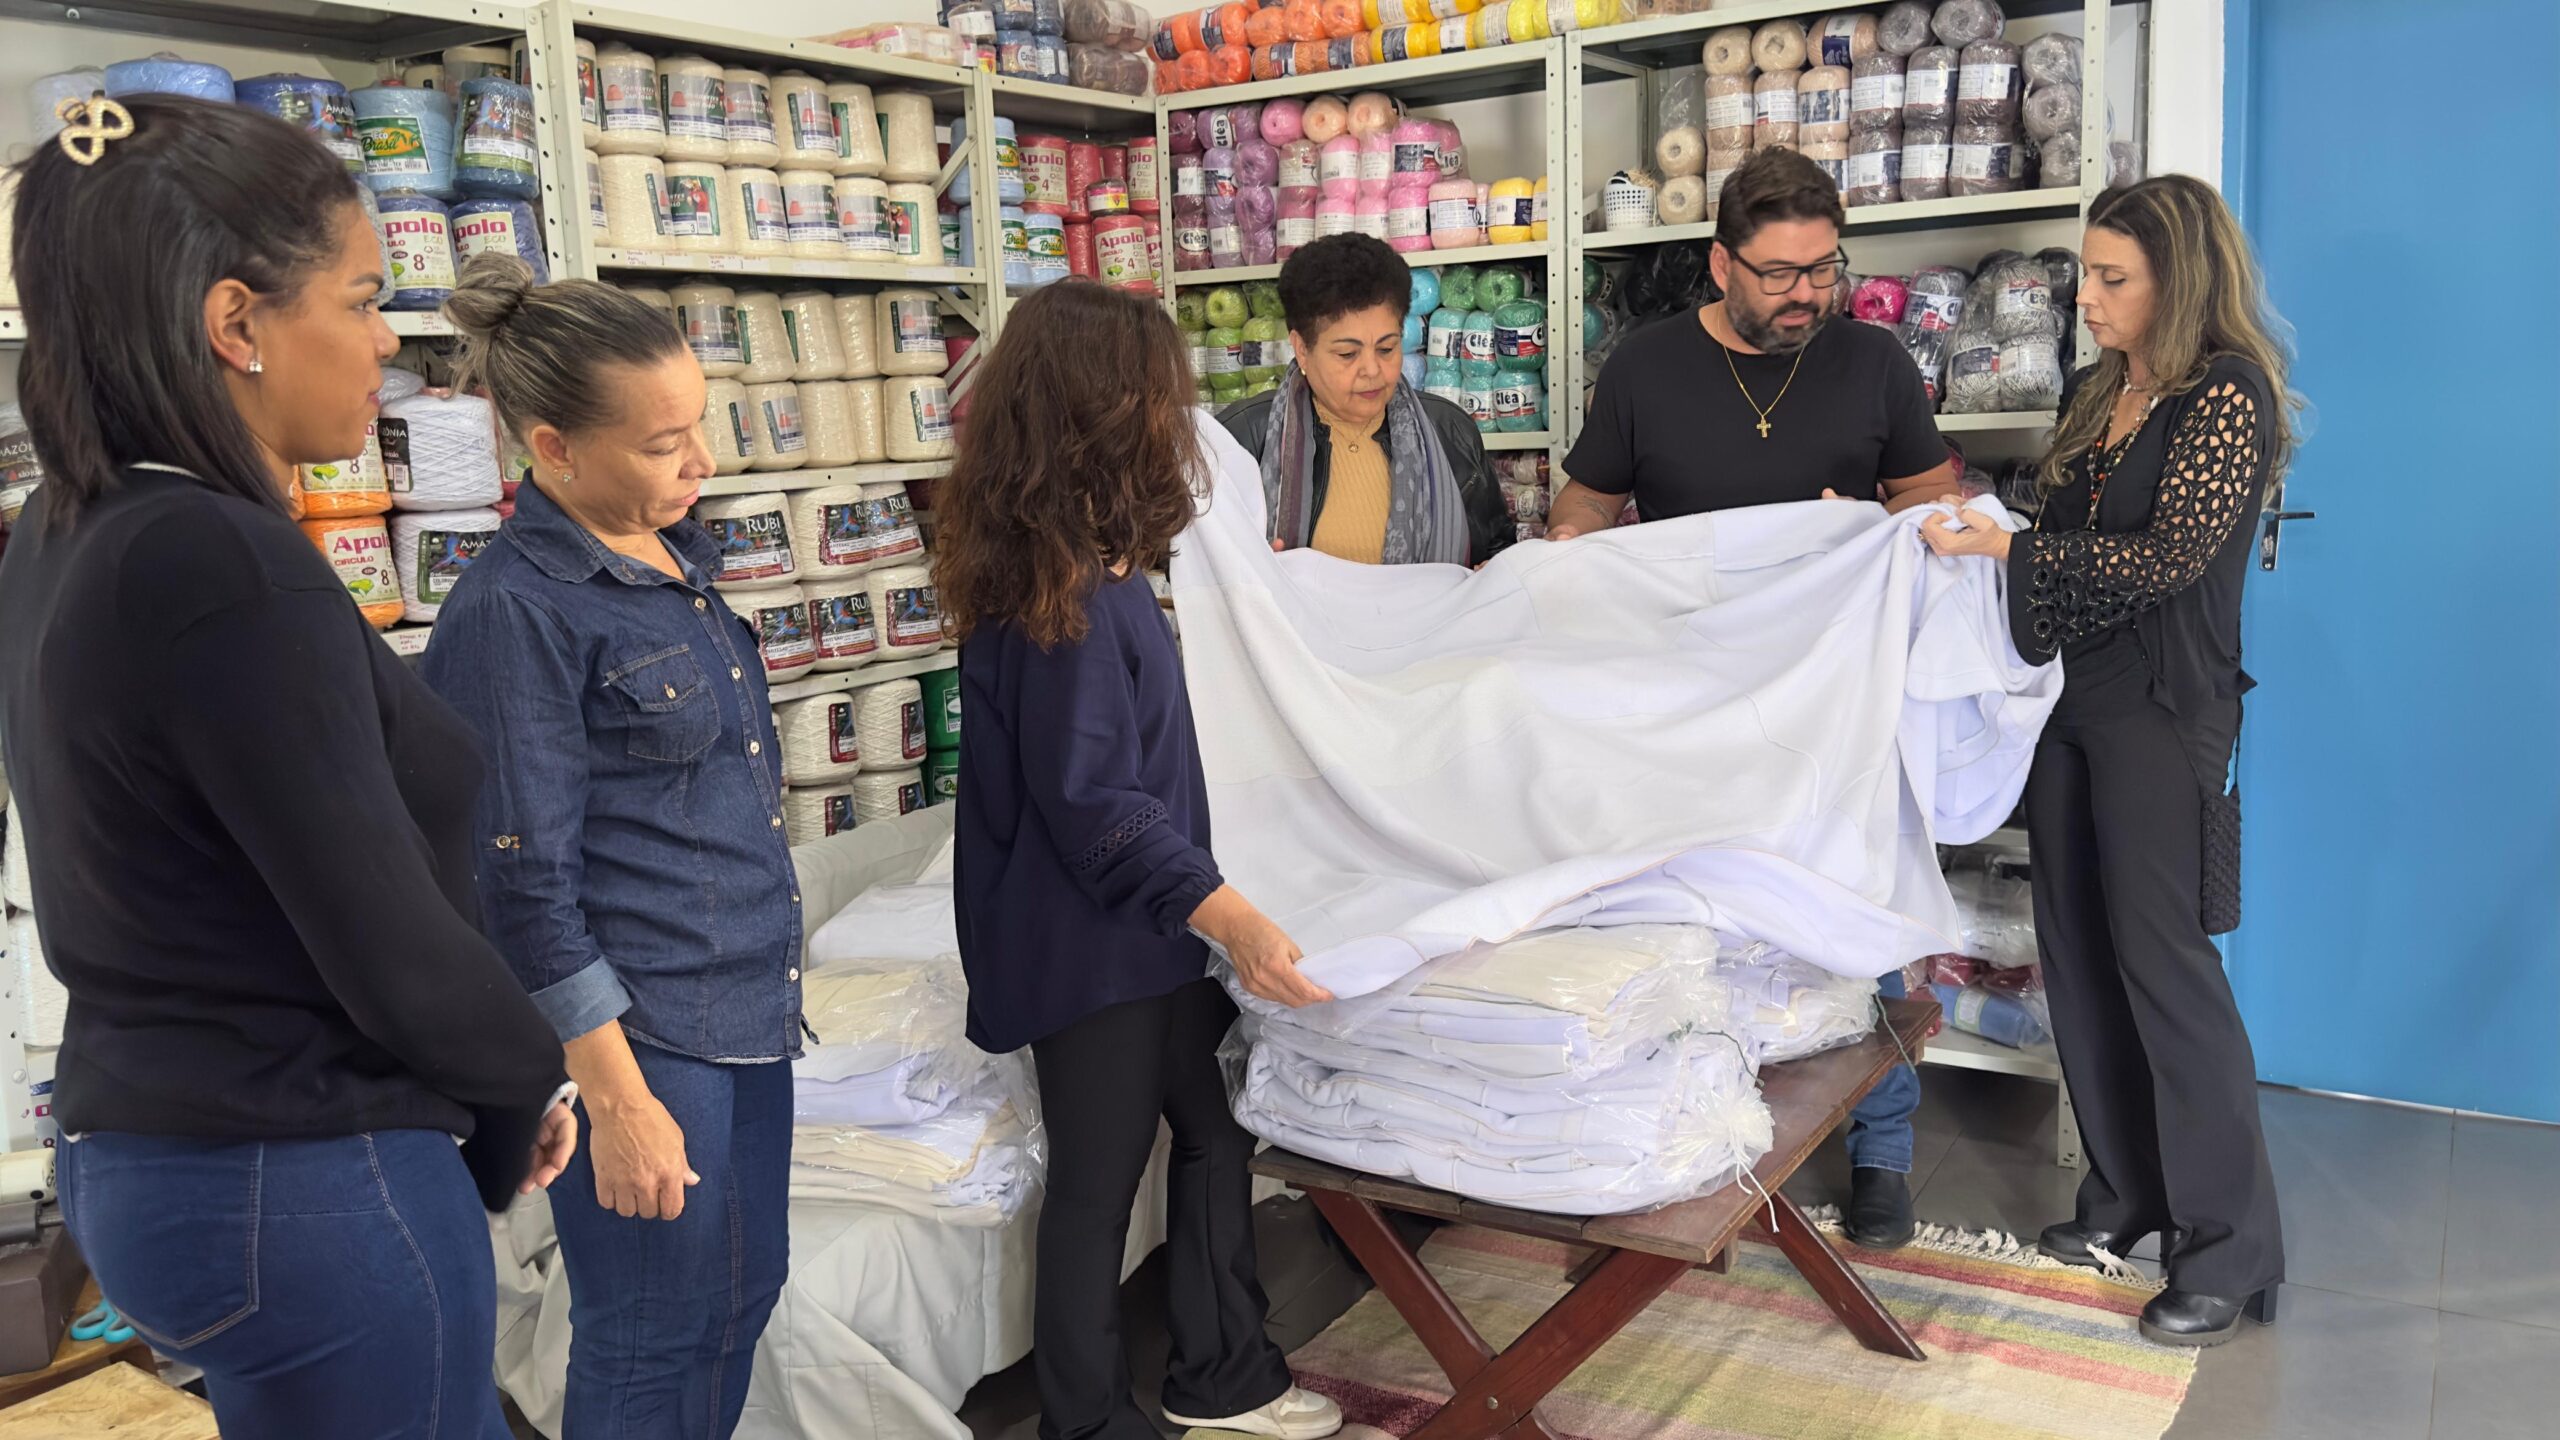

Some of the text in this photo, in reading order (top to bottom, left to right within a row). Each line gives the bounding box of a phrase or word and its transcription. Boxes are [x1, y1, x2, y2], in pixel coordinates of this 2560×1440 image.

[1042, 179, 1049, 191] 4
[1100, 232, 1143, 249] Apolo
[413, 254, 425, 271] 8
[1128, 258, 1135, 269] 4
[1495, 391, 1519, 405] Cléa
[746, 517, 780, 533] RUBI
[334, 556, 374, 567] CIRCULO
[381, 569, 389, 586] 8
